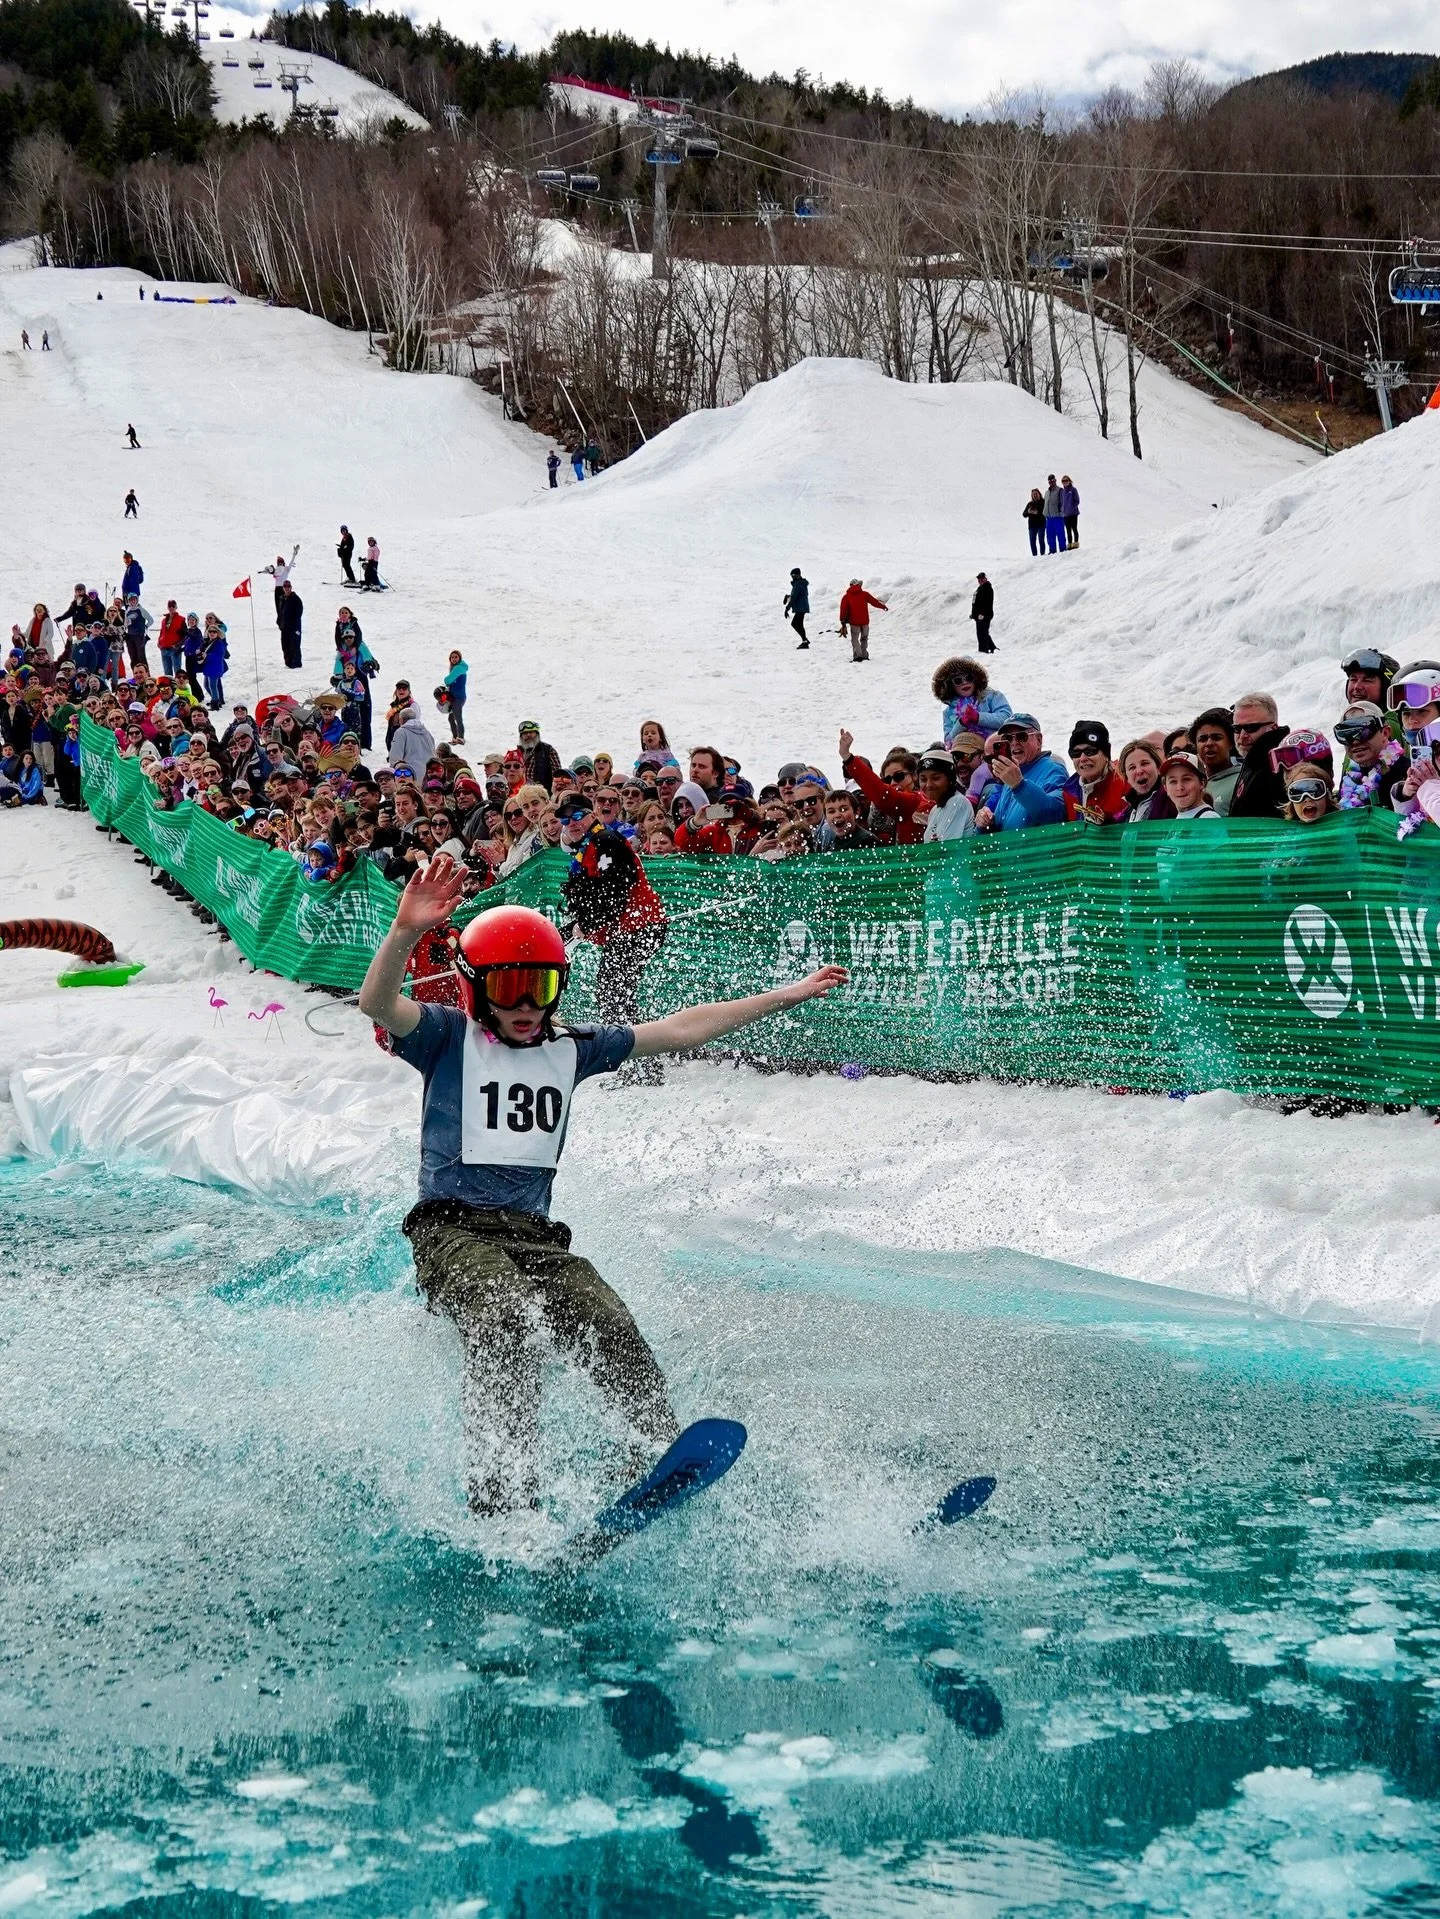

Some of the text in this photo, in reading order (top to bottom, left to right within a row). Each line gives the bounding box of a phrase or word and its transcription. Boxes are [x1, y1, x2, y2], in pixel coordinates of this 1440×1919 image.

[849, 905, 1079, 967] WATERVILLE
[964, 964, 1082, 1006] RESORT
[479, 1080, 563, 1133] 130
